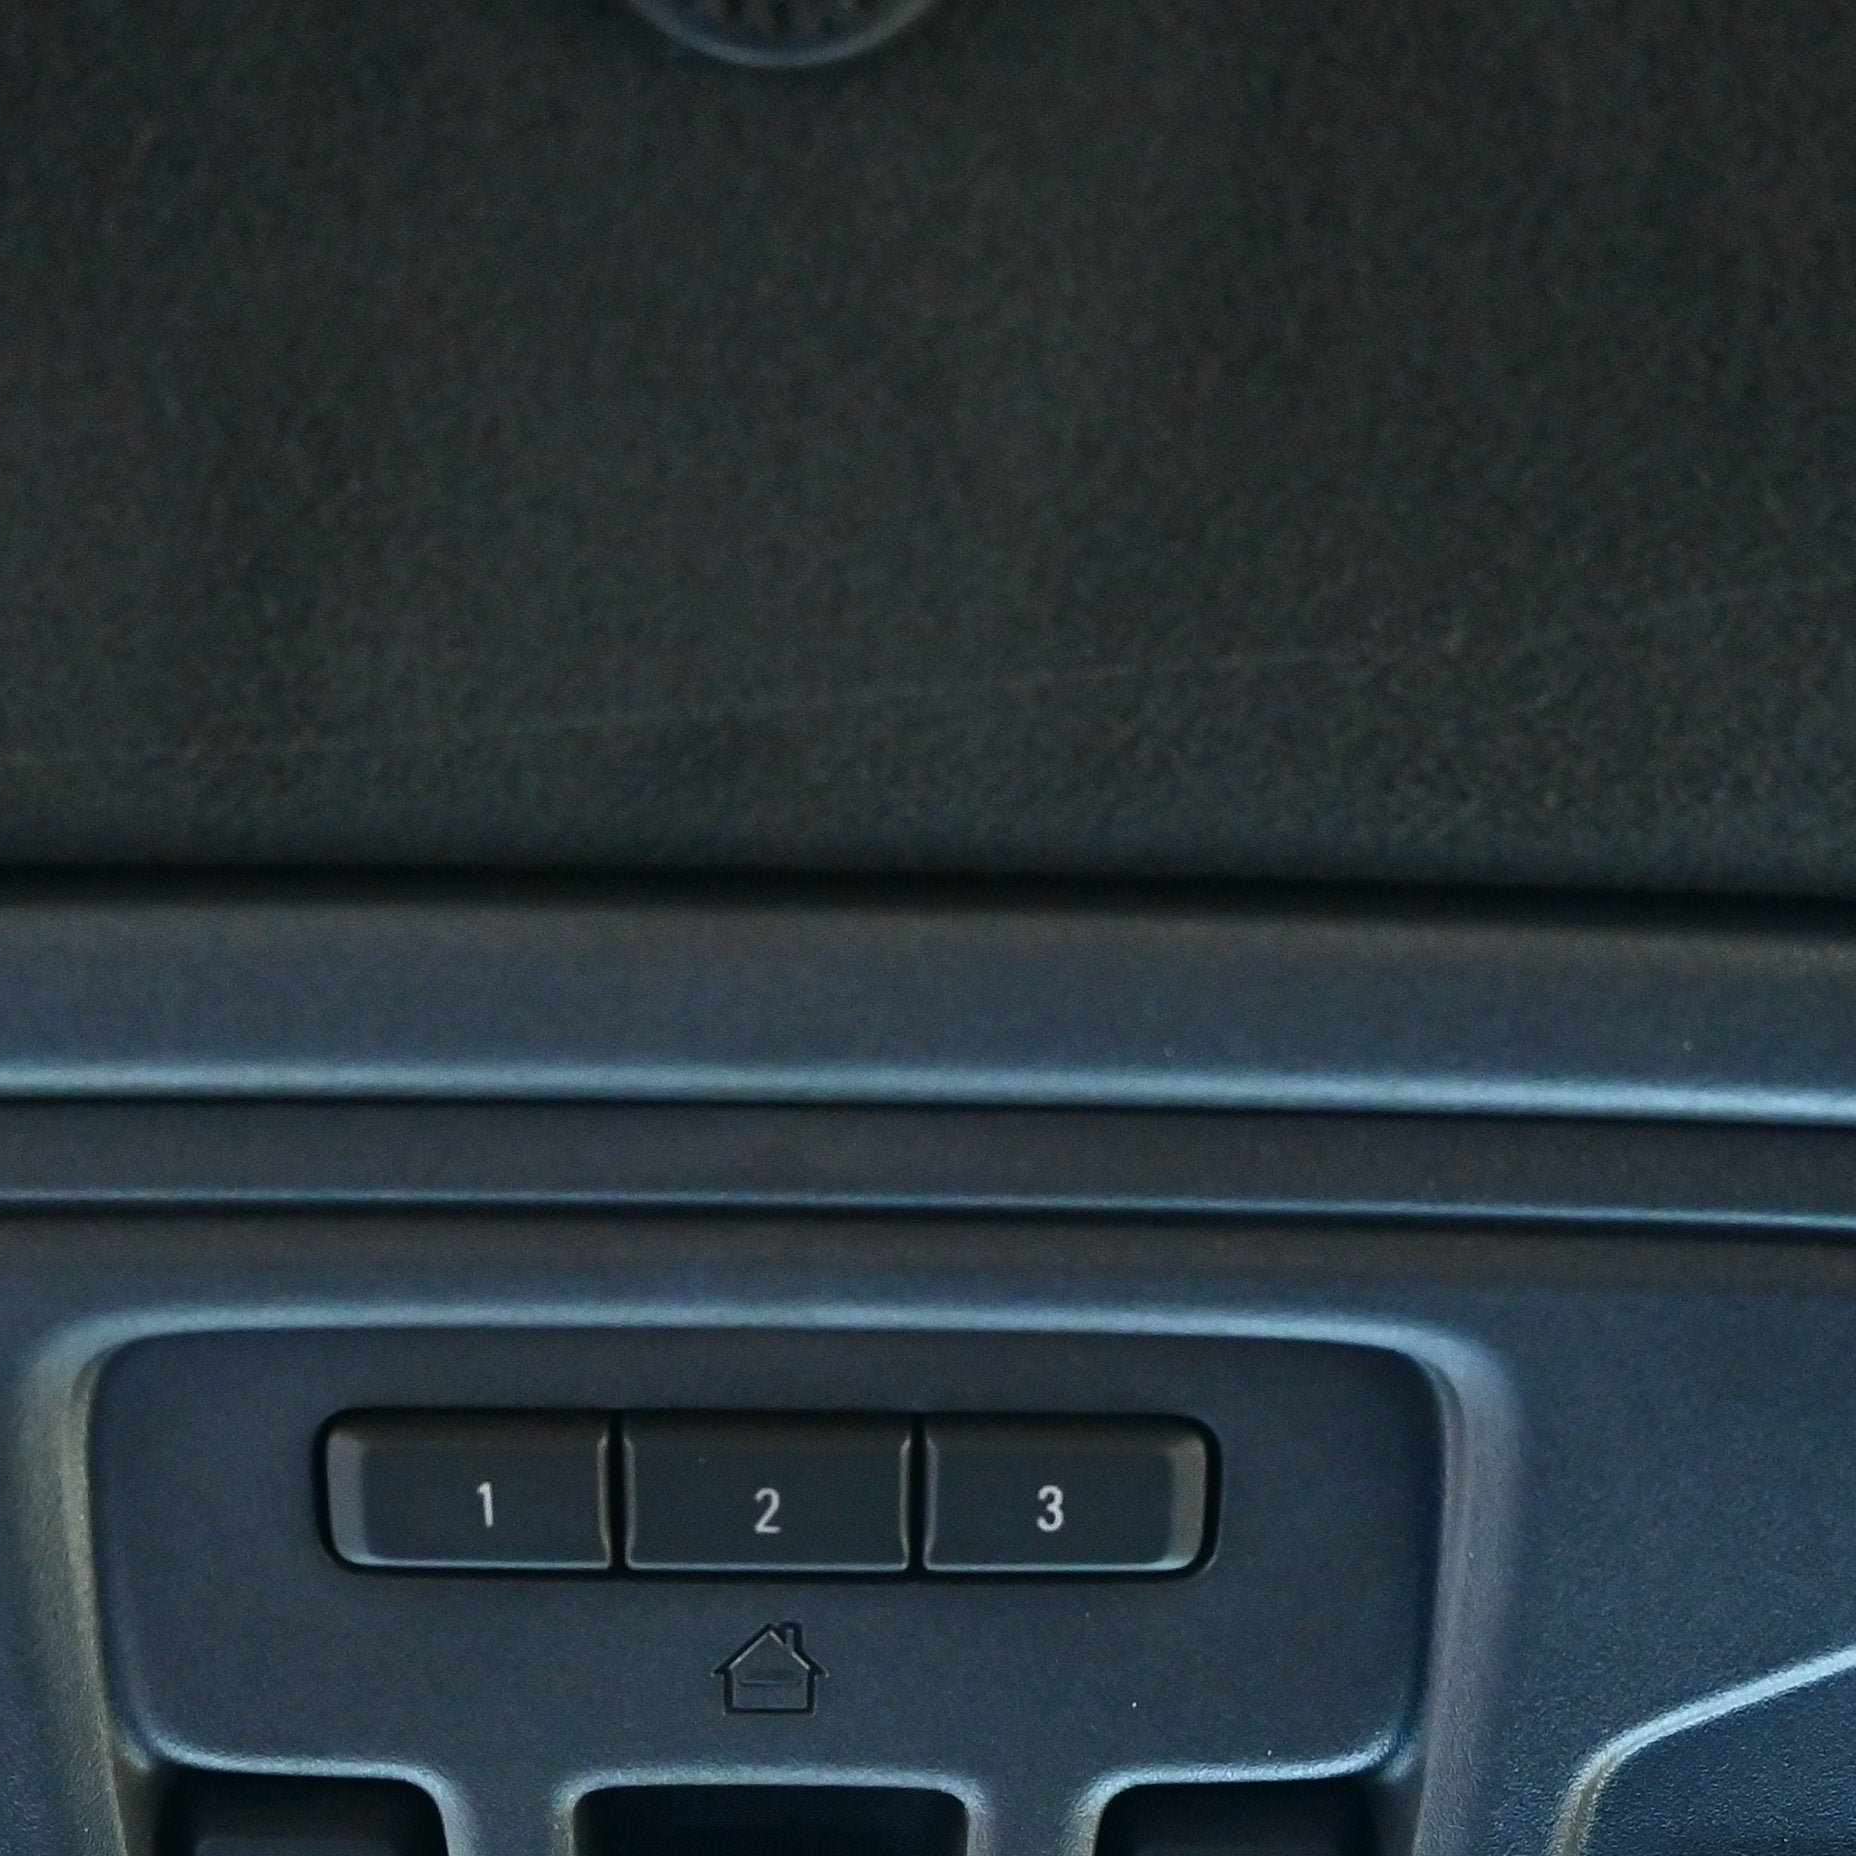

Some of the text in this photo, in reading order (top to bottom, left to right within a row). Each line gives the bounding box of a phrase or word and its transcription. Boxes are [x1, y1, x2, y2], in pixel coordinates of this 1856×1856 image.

[476, 1481, 494, 1528] 1
[754, 1487, 782, 1534] 2
[1036, 1485, 1065, 1532] 3
